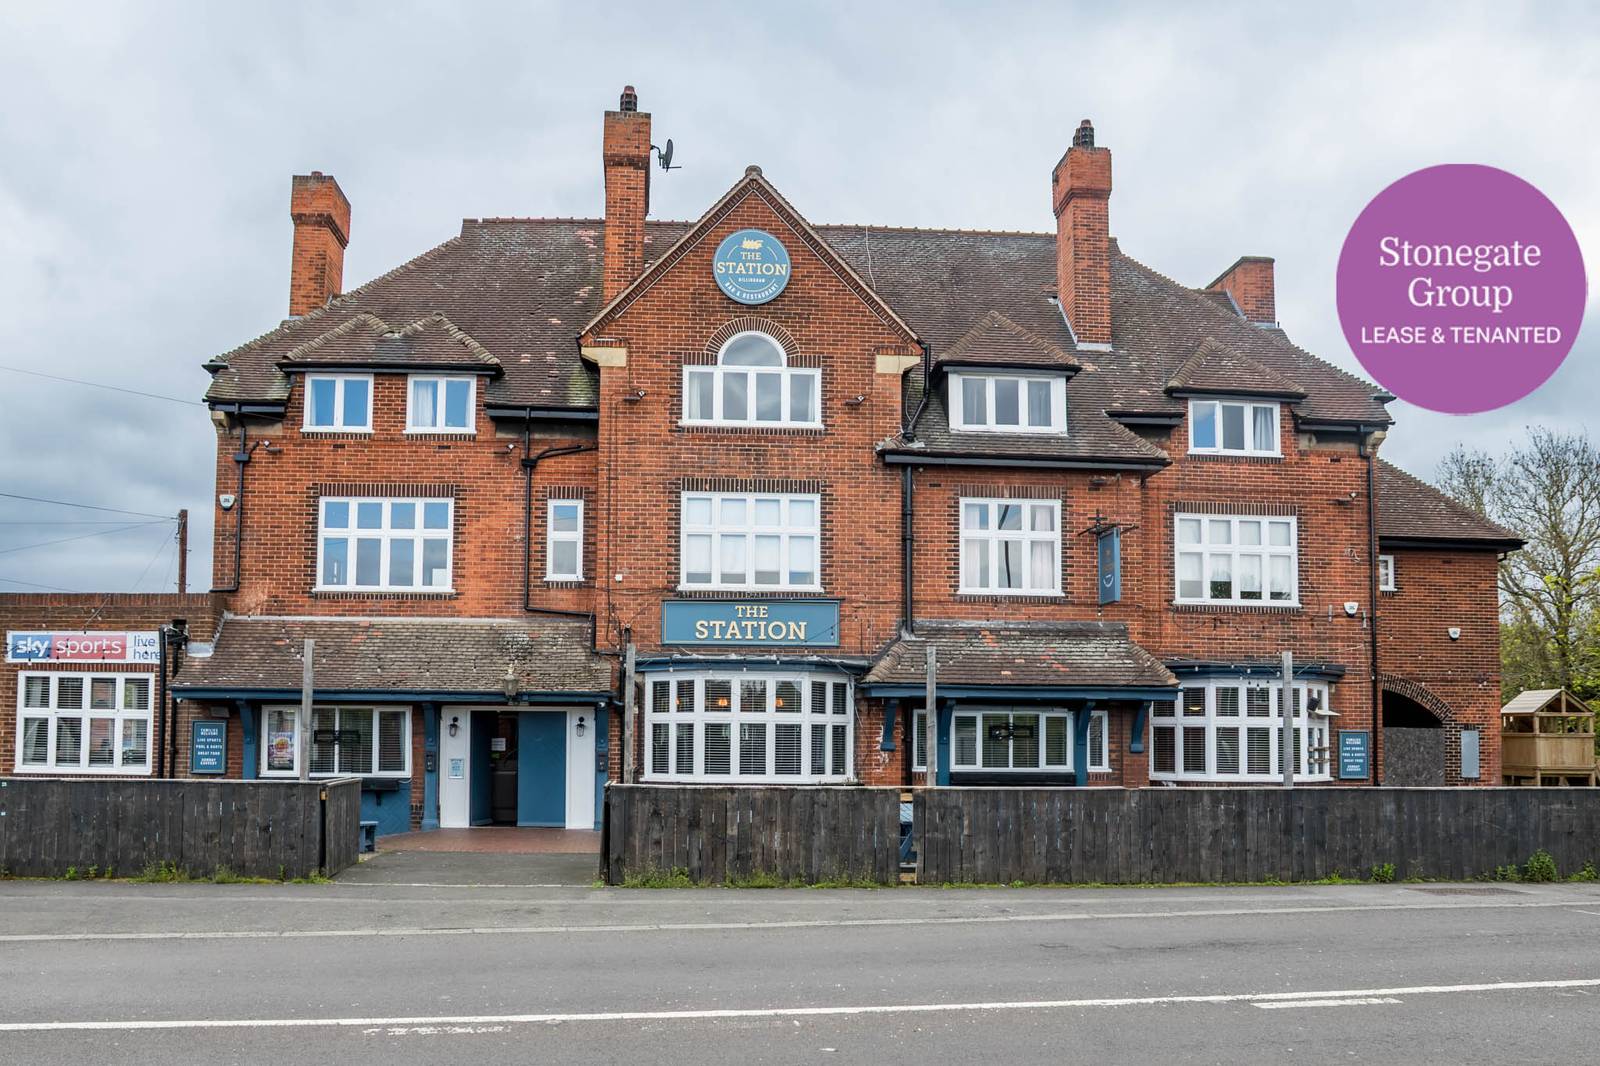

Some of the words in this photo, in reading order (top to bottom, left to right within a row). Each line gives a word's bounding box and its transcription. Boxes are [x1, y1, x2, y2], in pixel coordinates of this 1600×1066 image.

[740, 251, 762, 260] THE
[717, 262, 787, 276] STATION
[735, 605, 769, 618] THE
[695, 621, 808, 640] STATION
[16, 637, 50, 657] sky
[56, 638, 122, 657] sports
[134, 635, 156, 647] live
[133, 649, 160, 660] here
